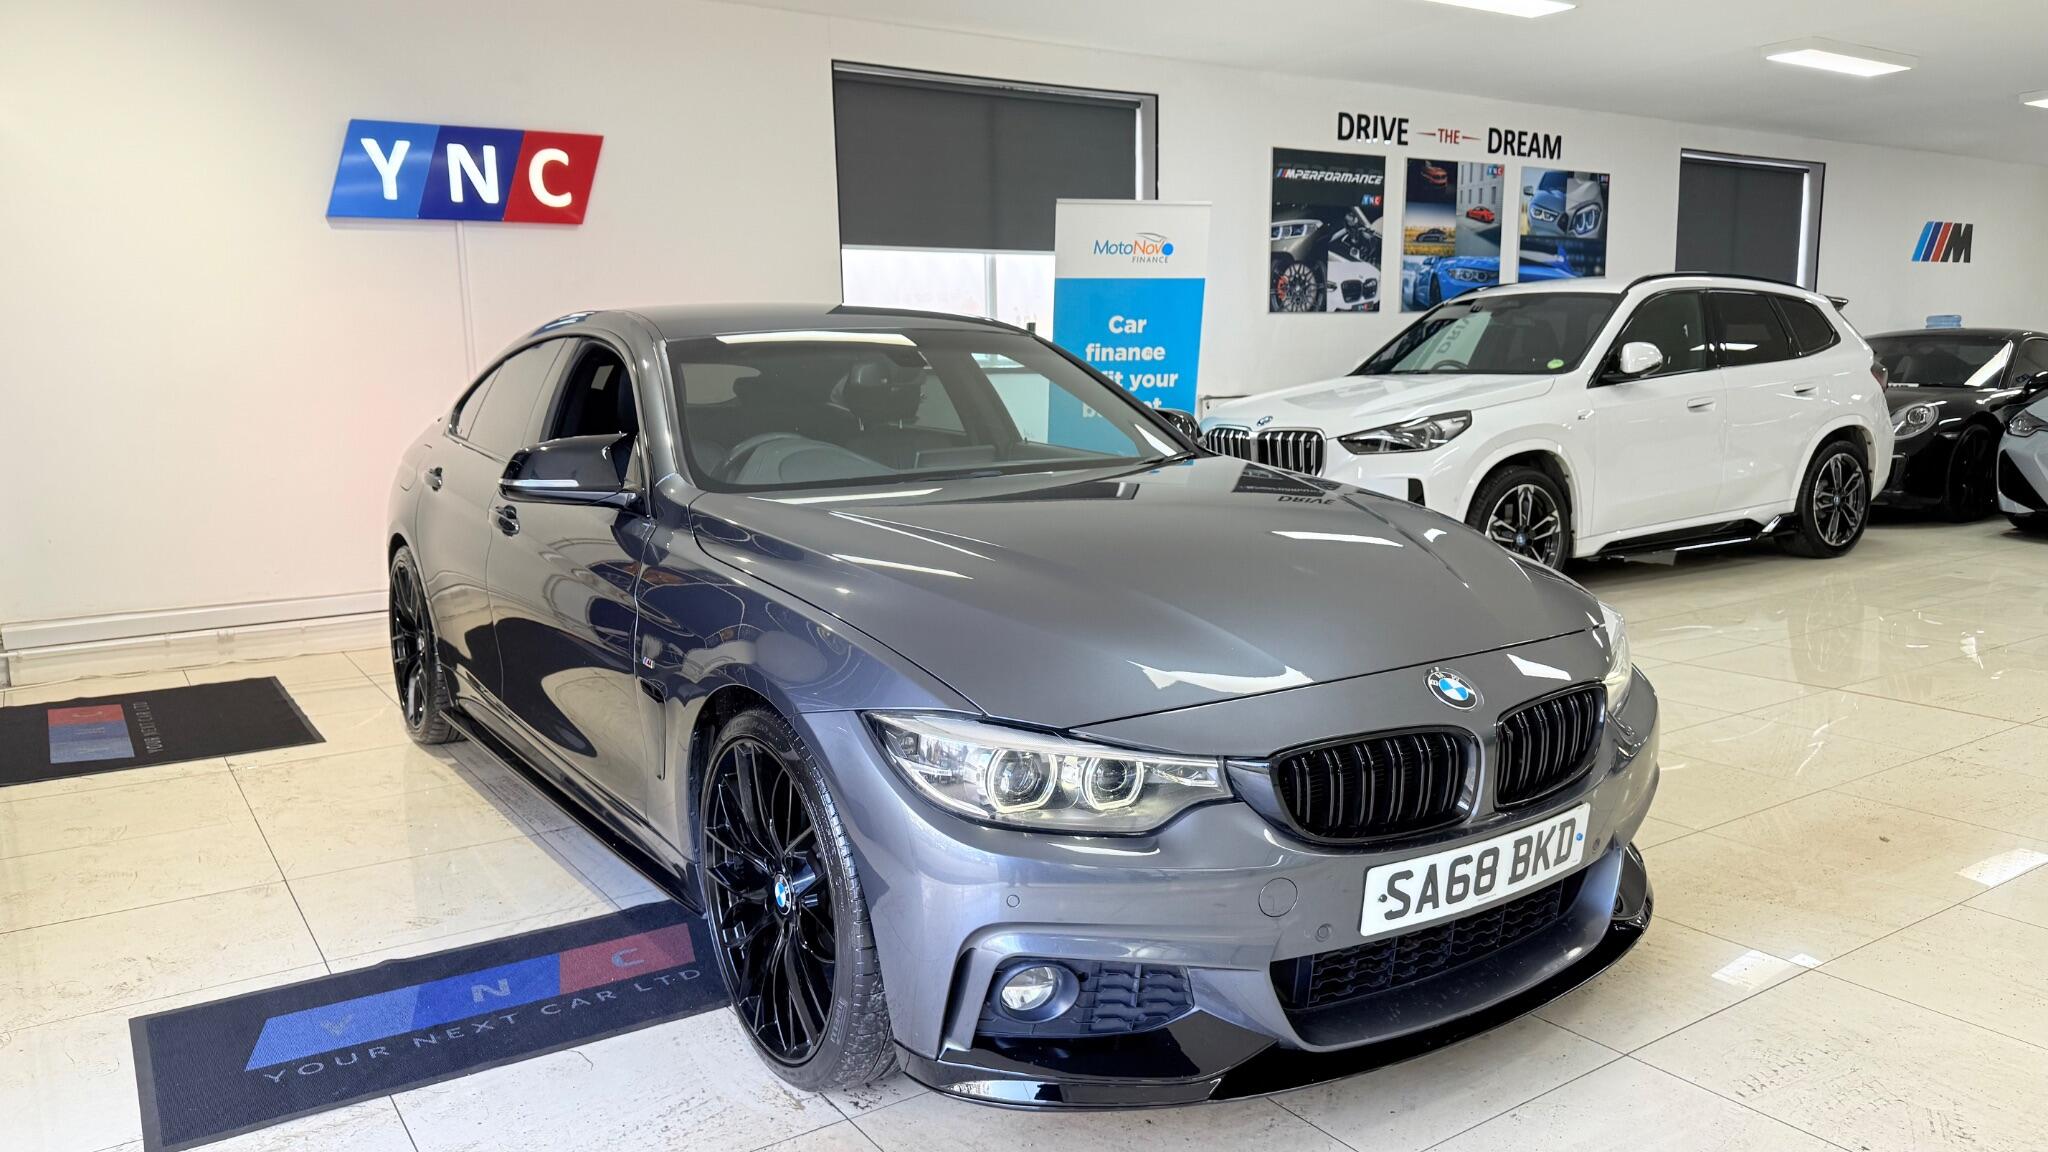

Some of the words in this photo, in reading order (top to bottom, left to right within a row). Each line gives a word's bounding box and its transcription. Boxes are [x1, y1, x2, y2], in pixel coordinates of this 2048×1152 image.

[1337, 112, 1409, 146] DRIVE
[1438, 128, 1460, 145] THE
[1487, 128, 1562, 160] DREAM
[361, 138, 572, 208] YNC
[1132, 256, 1169, 264] FINANCE
[1108, 315, 1147, 334] Car
[1085, 343, 1166, 361] finance
[1129, 373, 1179, 391] your
[1384, 846, 1500, 921] SA68
[1507, 817, 1577, 886] BKD
[264, 1046, 390, 1083] YOUR
[412, 1012, 519, 1048] NEXT
[540, 990, 617, 1015] CAR
[633, 969, 701, 992] LTD
